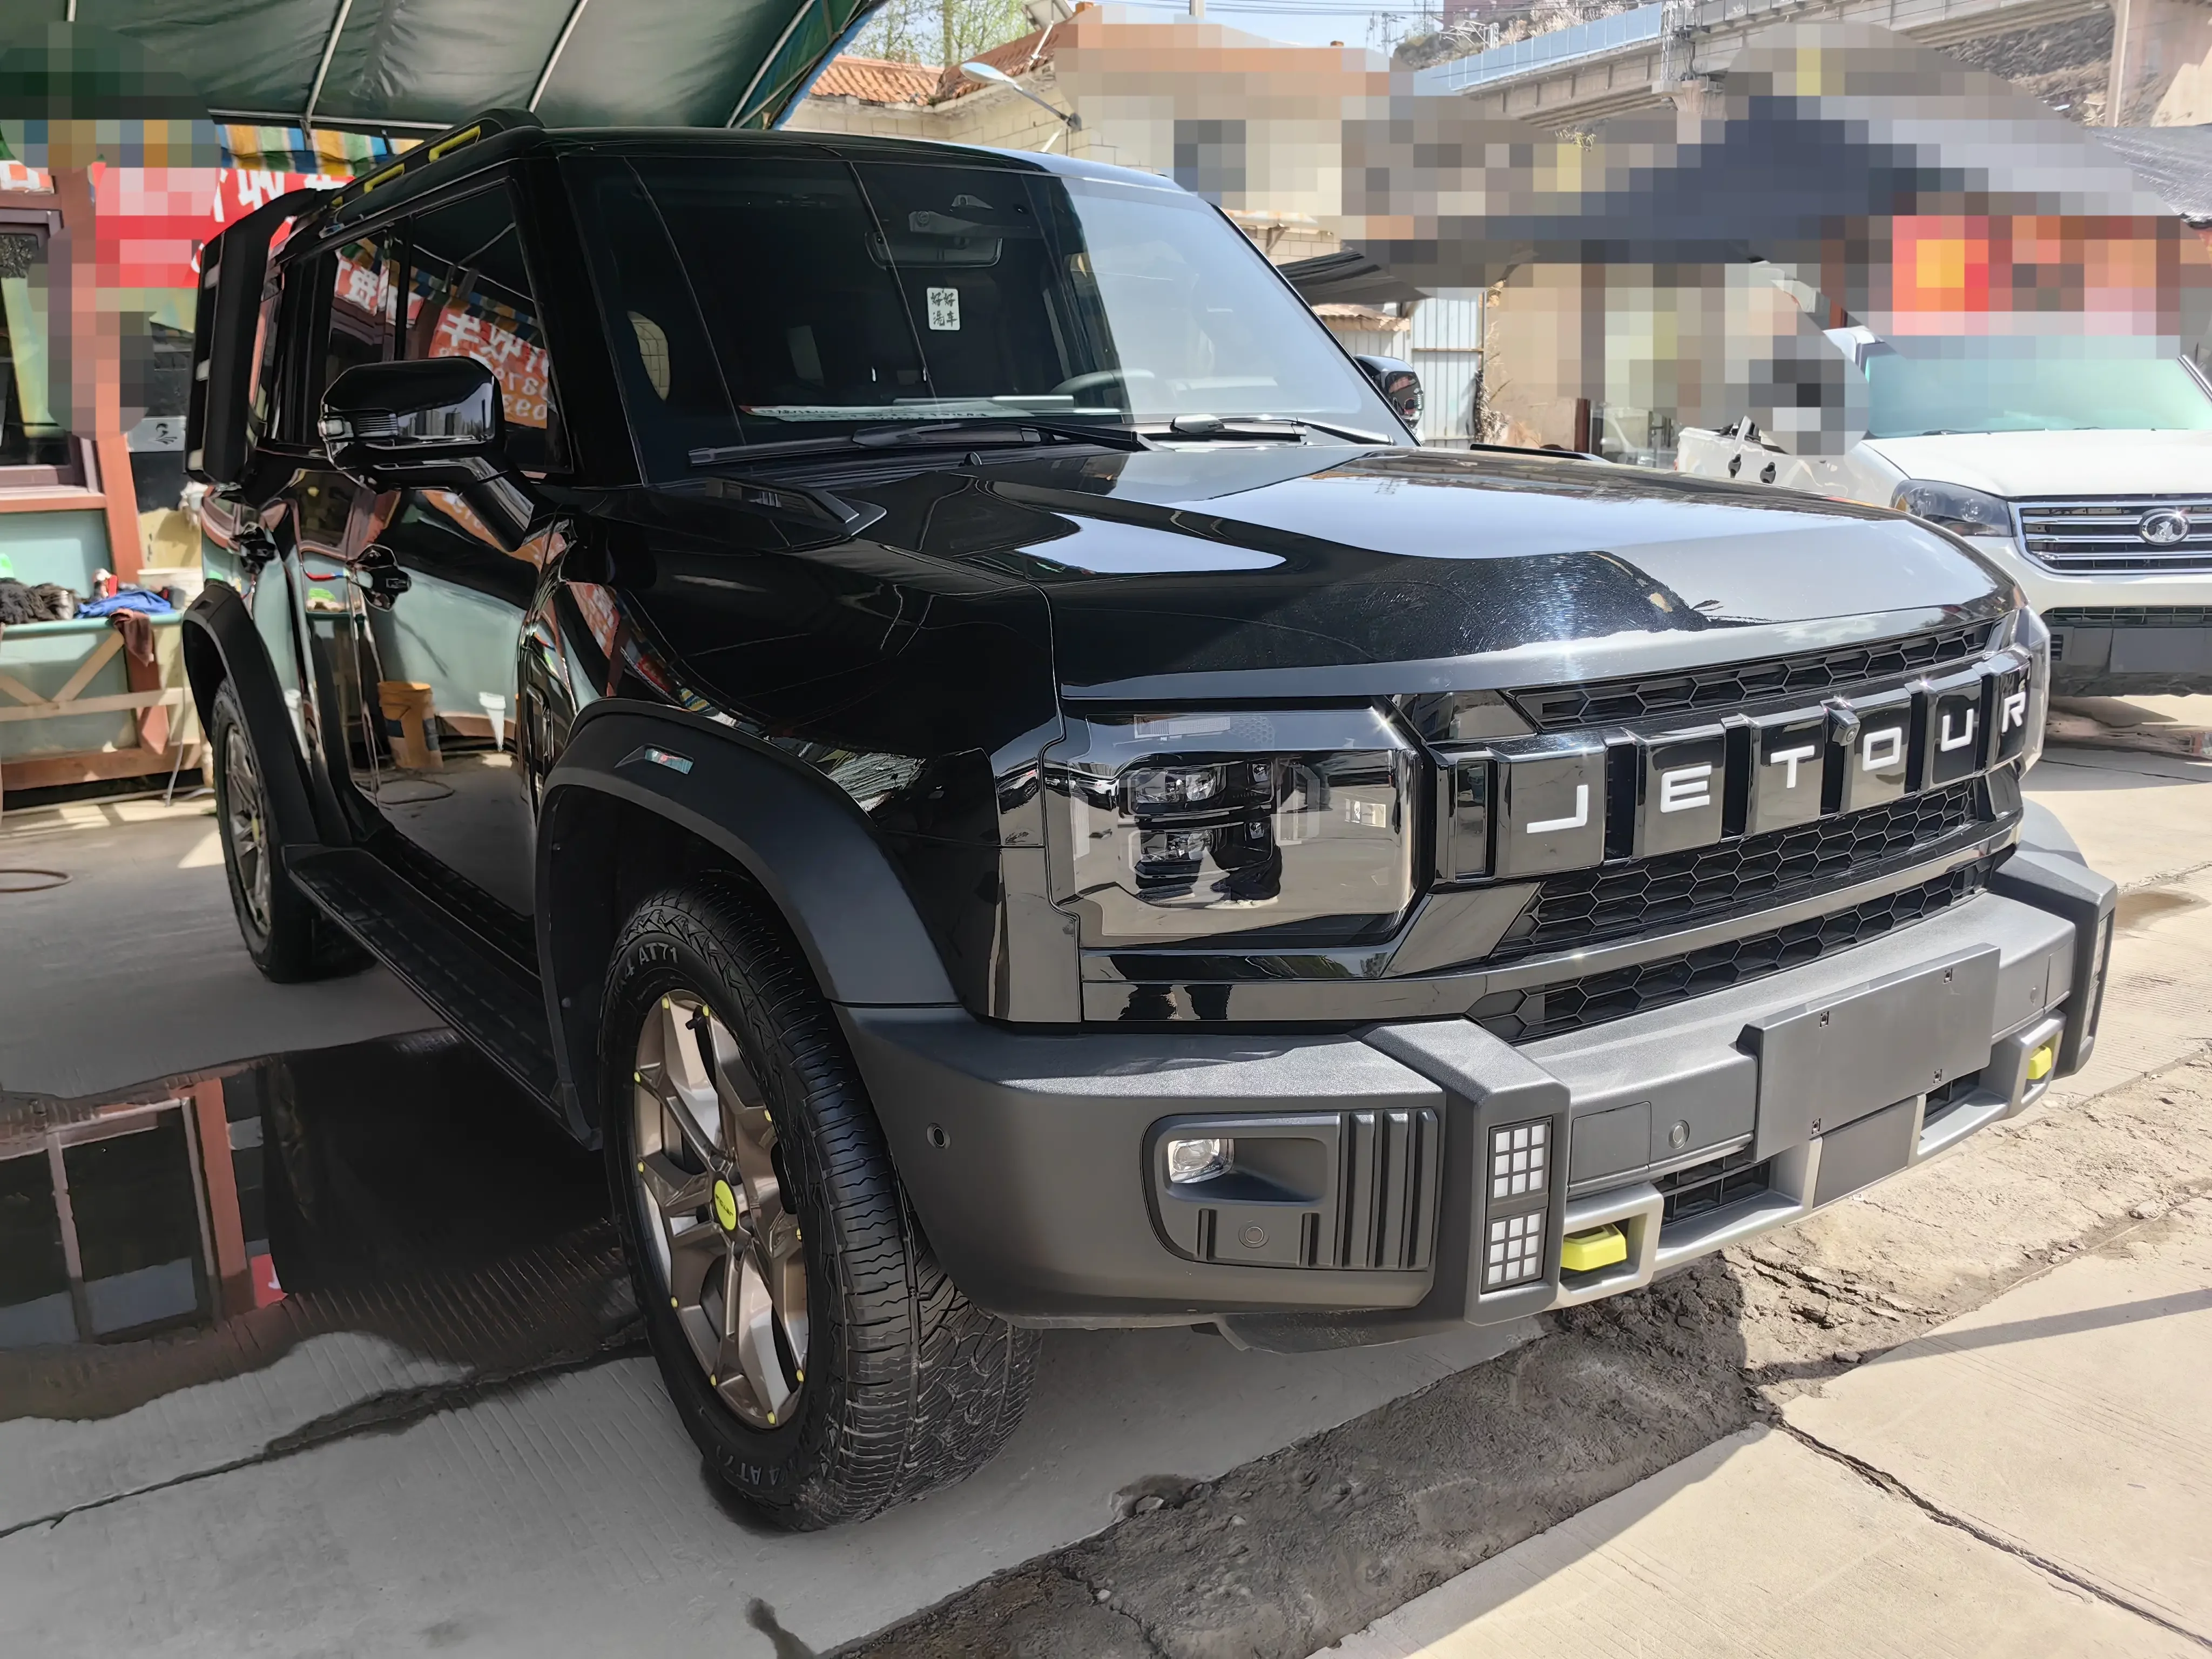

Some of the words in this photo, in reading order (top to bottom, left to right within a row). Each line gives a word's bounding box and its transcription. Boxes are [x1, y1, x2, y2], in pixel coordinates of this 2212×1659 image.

[930, 292, 956, 307] 好好
[933, 310, 957, 327] 洗车
[1526, 691, 2025, 834] JETOUR
[638, 942, 678, 966] AT71
